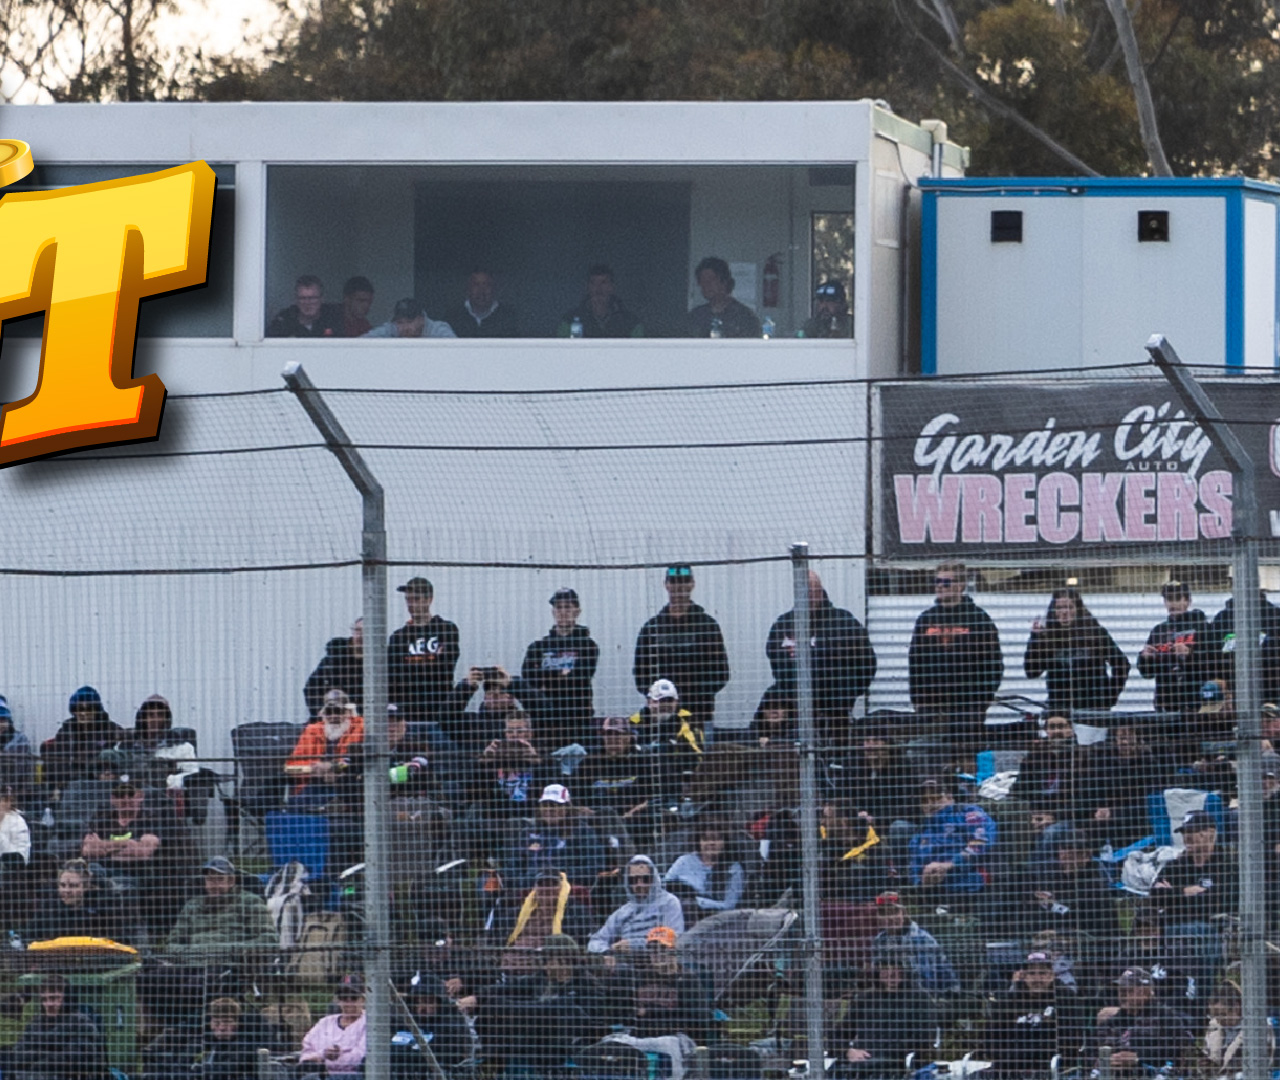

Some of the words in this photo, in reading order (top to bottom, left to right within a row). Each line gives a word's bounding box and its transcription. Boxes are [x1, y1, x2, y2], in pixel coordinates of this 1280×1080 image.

[913, 412, 1102, 494] Garden
[1114, 401, 1213, 485] City
[1125, 460, 1179, 472] AUTO
[895, 470, 1233, 544] WRECKERS
